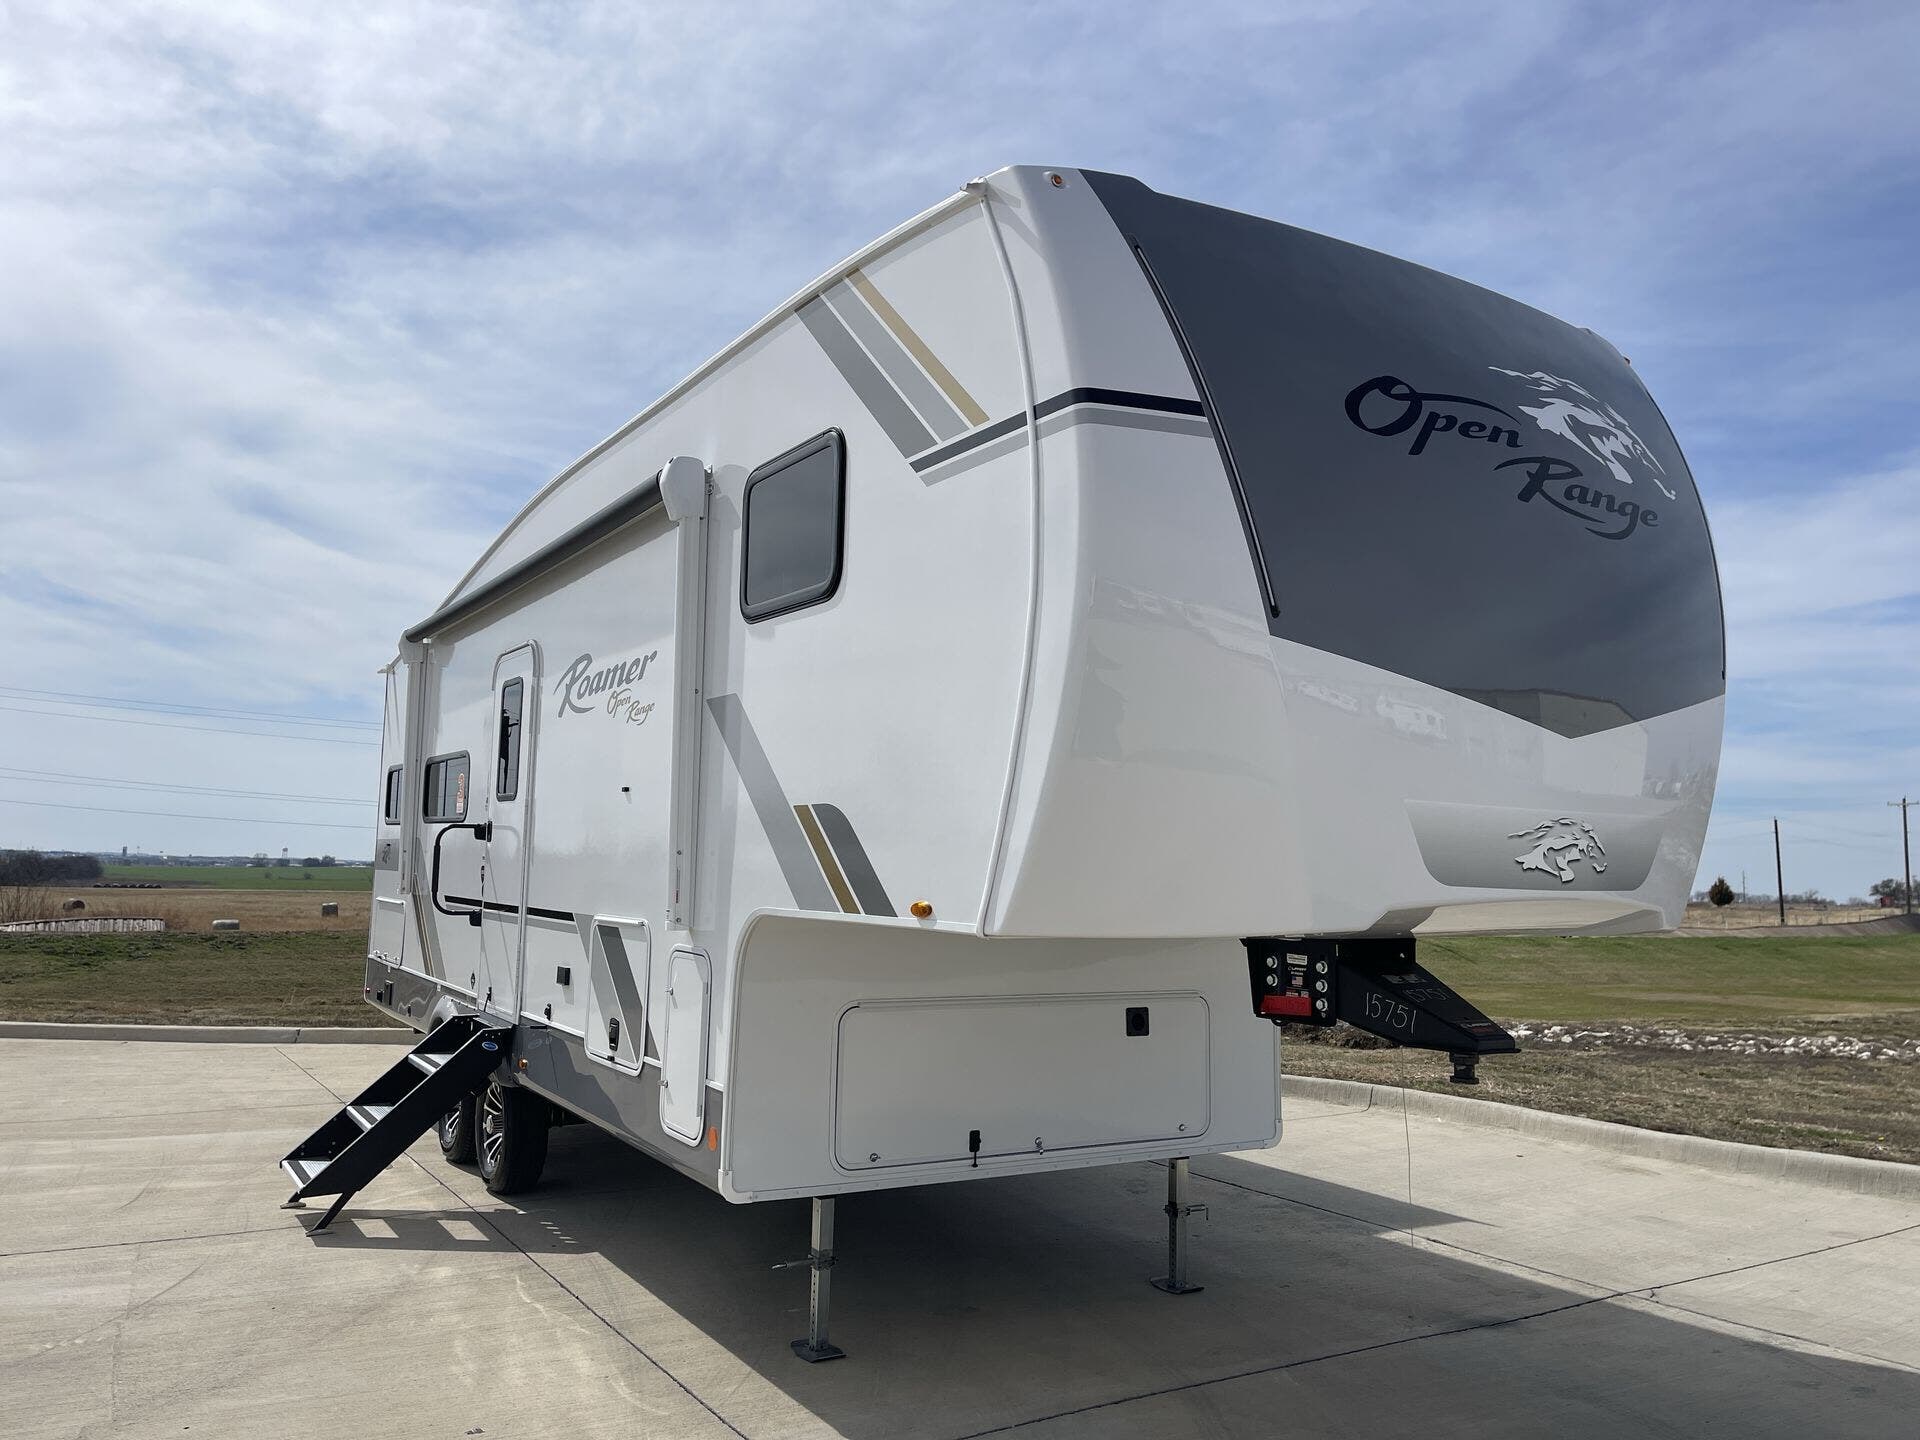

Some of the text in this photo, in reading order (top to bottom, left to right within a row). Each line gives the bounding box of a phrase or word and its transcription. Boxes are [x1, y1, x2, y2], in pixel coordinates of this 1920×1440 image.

[1344, 375, 1523, 456] Open
[1492, 456, 1659, 540] Range
[553, 650, 658, 718] Roamer
[606, 688, 632, 719] Open
[624, 700, 656, 726] Range
[1365, 992, 1417, 1035] 15751
